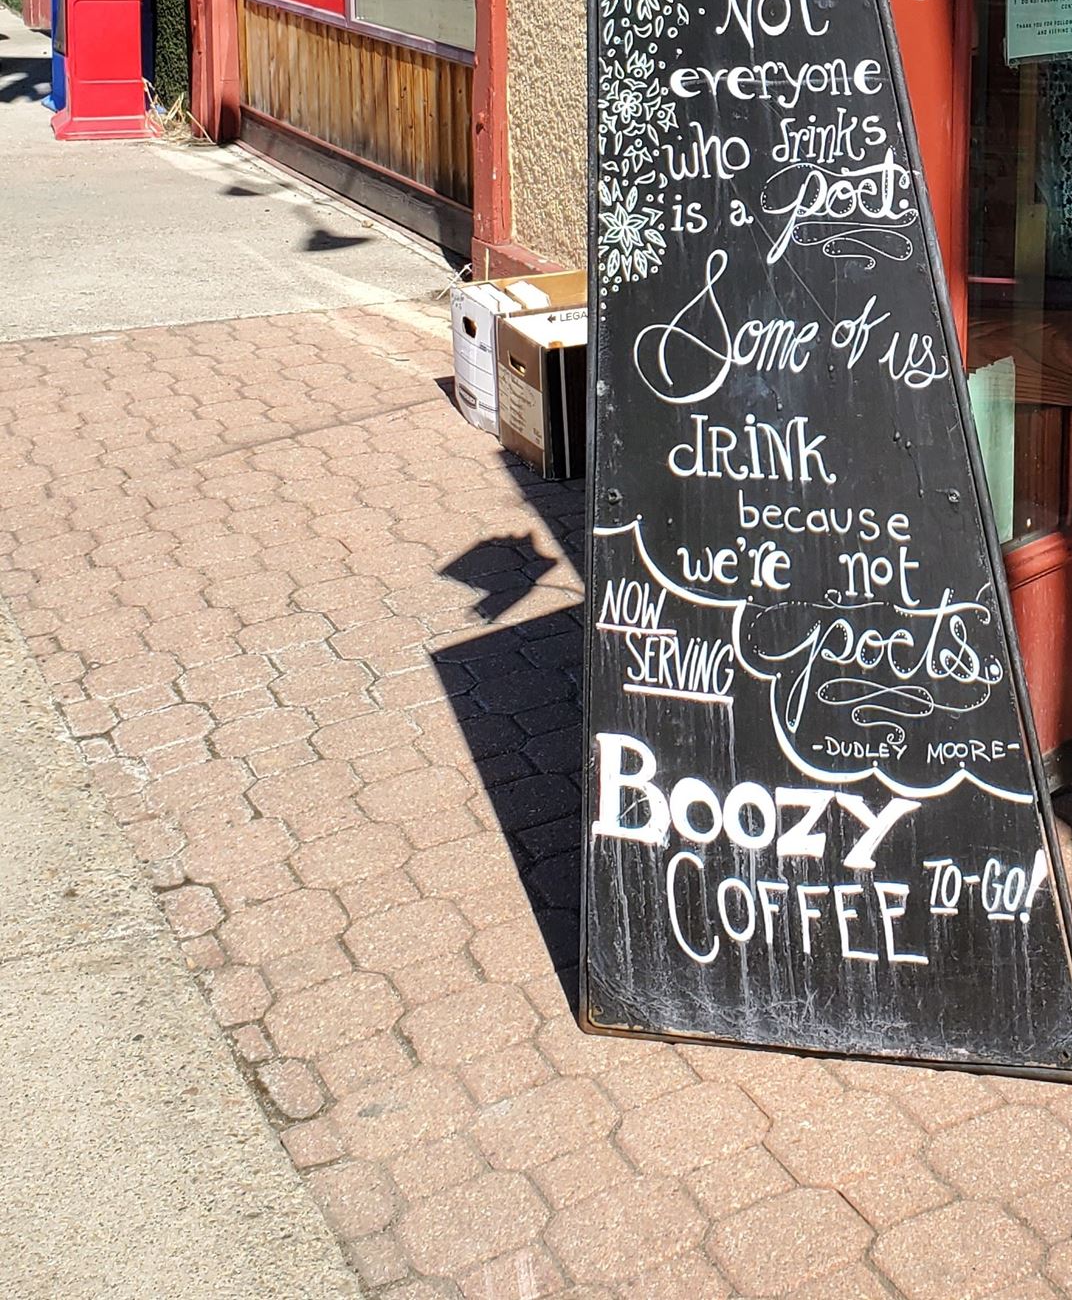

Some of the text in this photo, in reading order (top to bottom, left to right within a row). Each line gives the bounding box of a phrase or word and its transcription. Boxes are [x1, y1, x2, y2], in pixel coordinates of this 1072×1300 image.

[670, 58, 882, 108] everyone
[662, 108, 887, 180] who drinks
[671, 199, 707, 233] is
[730, 199, 753, 226] a
[559, 311, 588, 322] LEGA
[634, 249, 948, 403] Some of us
[739, 490, 911, 541] because
[677, 536, 919, 605] we're not
[599, 578, 667, 630] NOW
[667, 849, 1048, 964] COFFEE TO-GO!
